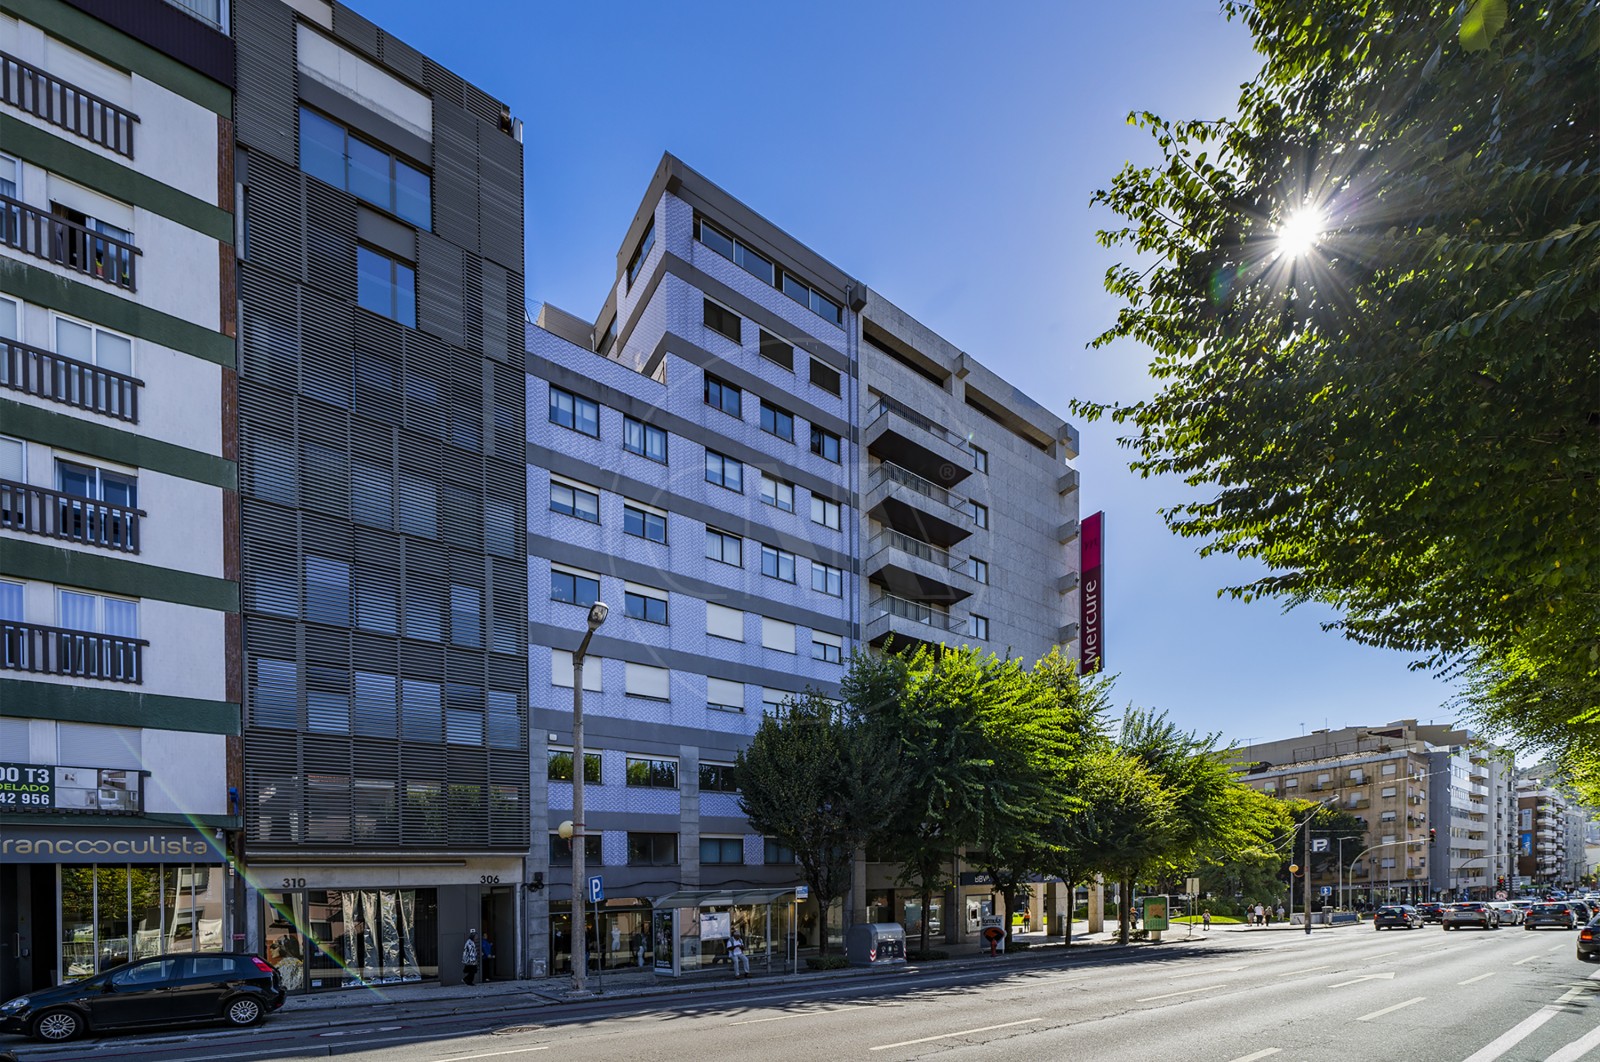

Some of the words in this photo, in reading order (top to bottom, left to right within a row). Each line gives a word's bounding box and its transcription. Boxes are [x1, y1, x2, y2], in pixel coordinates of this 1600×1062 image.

[1084, 579, 1097, 665] Mercure
[25, 768, 50, 784] T3
[0, 793, 16, 804] 42
[22, 794, 50, 805] 956
[0, 835, 208, 855] rancooculista
[282, 878, 306, 888] 310
[480, 875, 500, 884] 306
[592, 879, 601, 899] P
